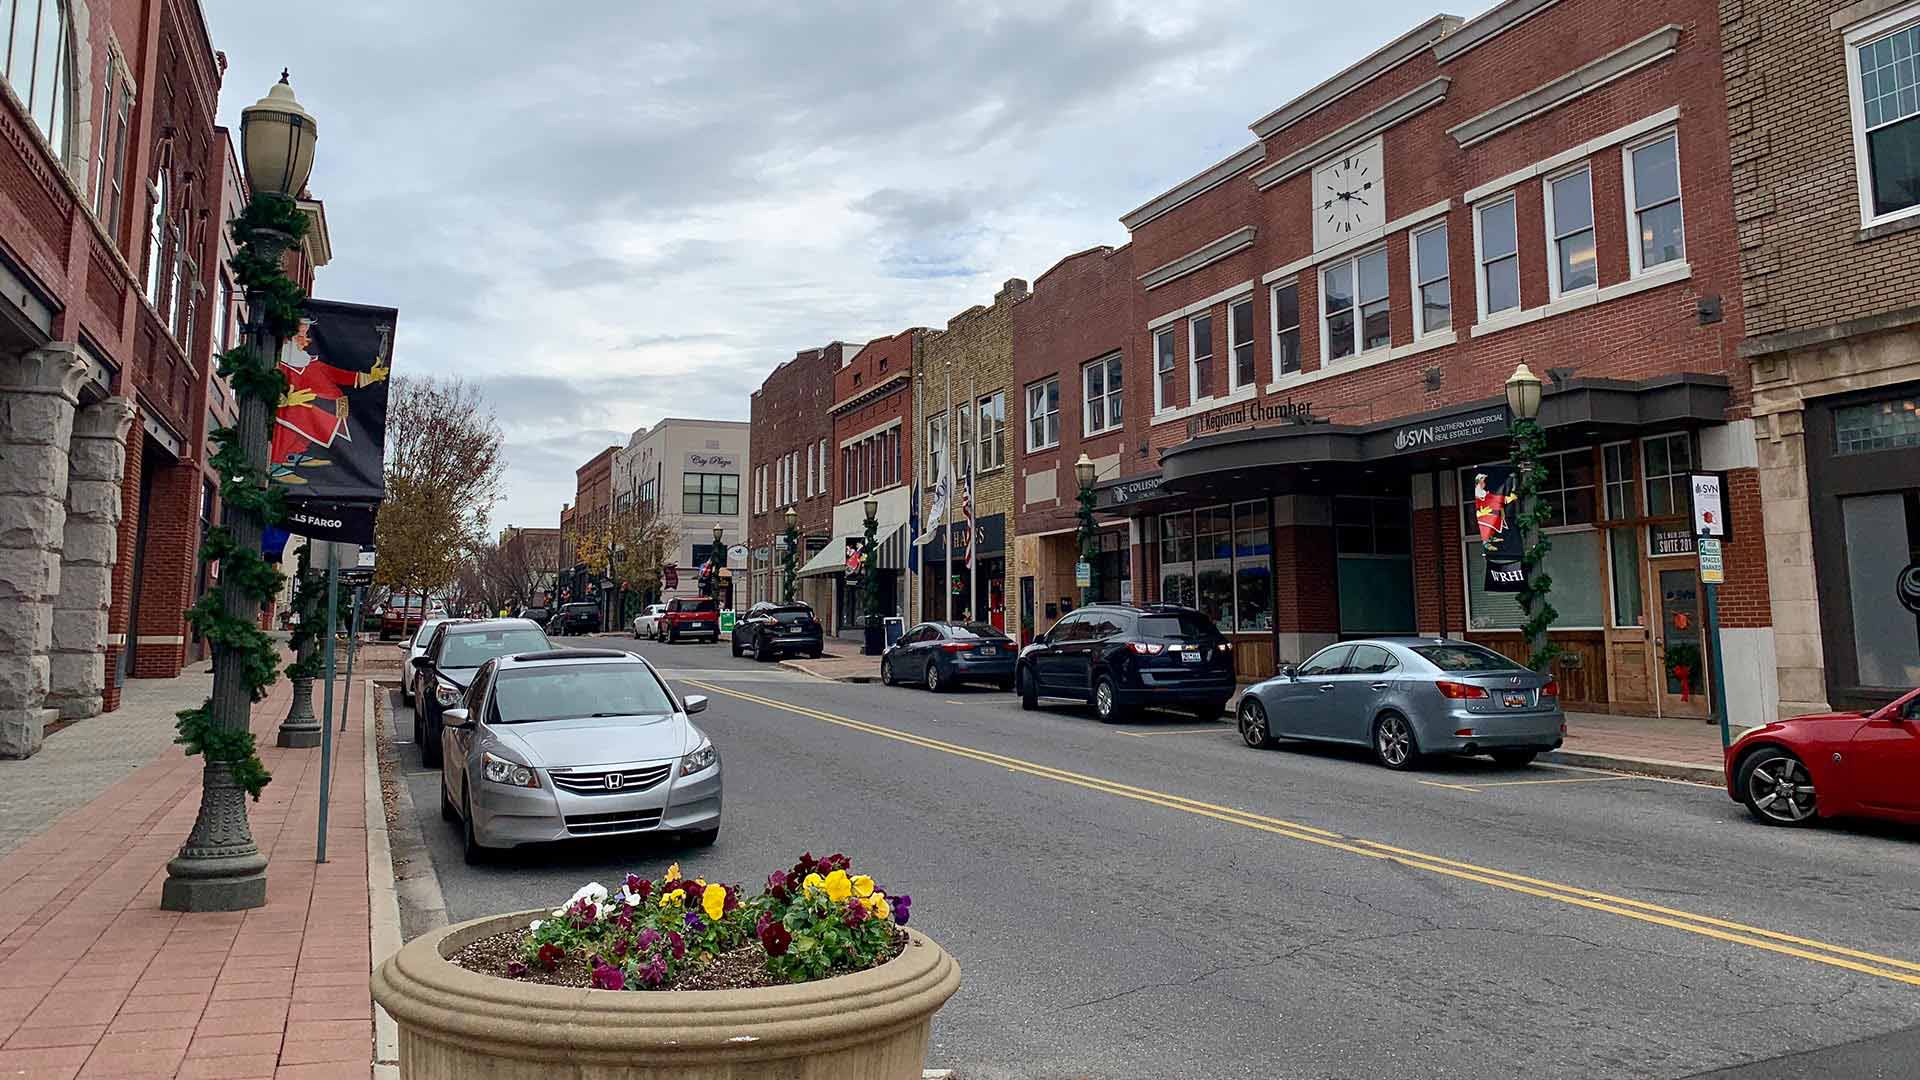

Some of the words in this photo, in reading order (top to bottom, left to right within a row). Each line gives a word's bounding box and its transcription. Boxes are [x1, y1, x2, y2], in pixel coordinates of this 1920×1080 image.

[1206, 402, 1247, 433] Regional
[1250, 397, 1313, 421] Chamber
[1435, 420, 1465, 433] SOUTHERN
[1466, 414, 1503, 426] COMMERCIAL
[1408, 426, 1434, 446] SVN
[1435, 432, 1449, 441] REAL
[1472, 426, 1484, 435] LLC
[691, 454, 708, 467] City
[709, 456, 732, 468] Plaza
[1703, 484, 1719, 494] SVN
[308, 516, 342, 528] FARGO
[1660, 540, 1679, 553] SUITE
[1680, 538, 1692, 552] 201
[1491, 569, 1525, 582] WRHI
